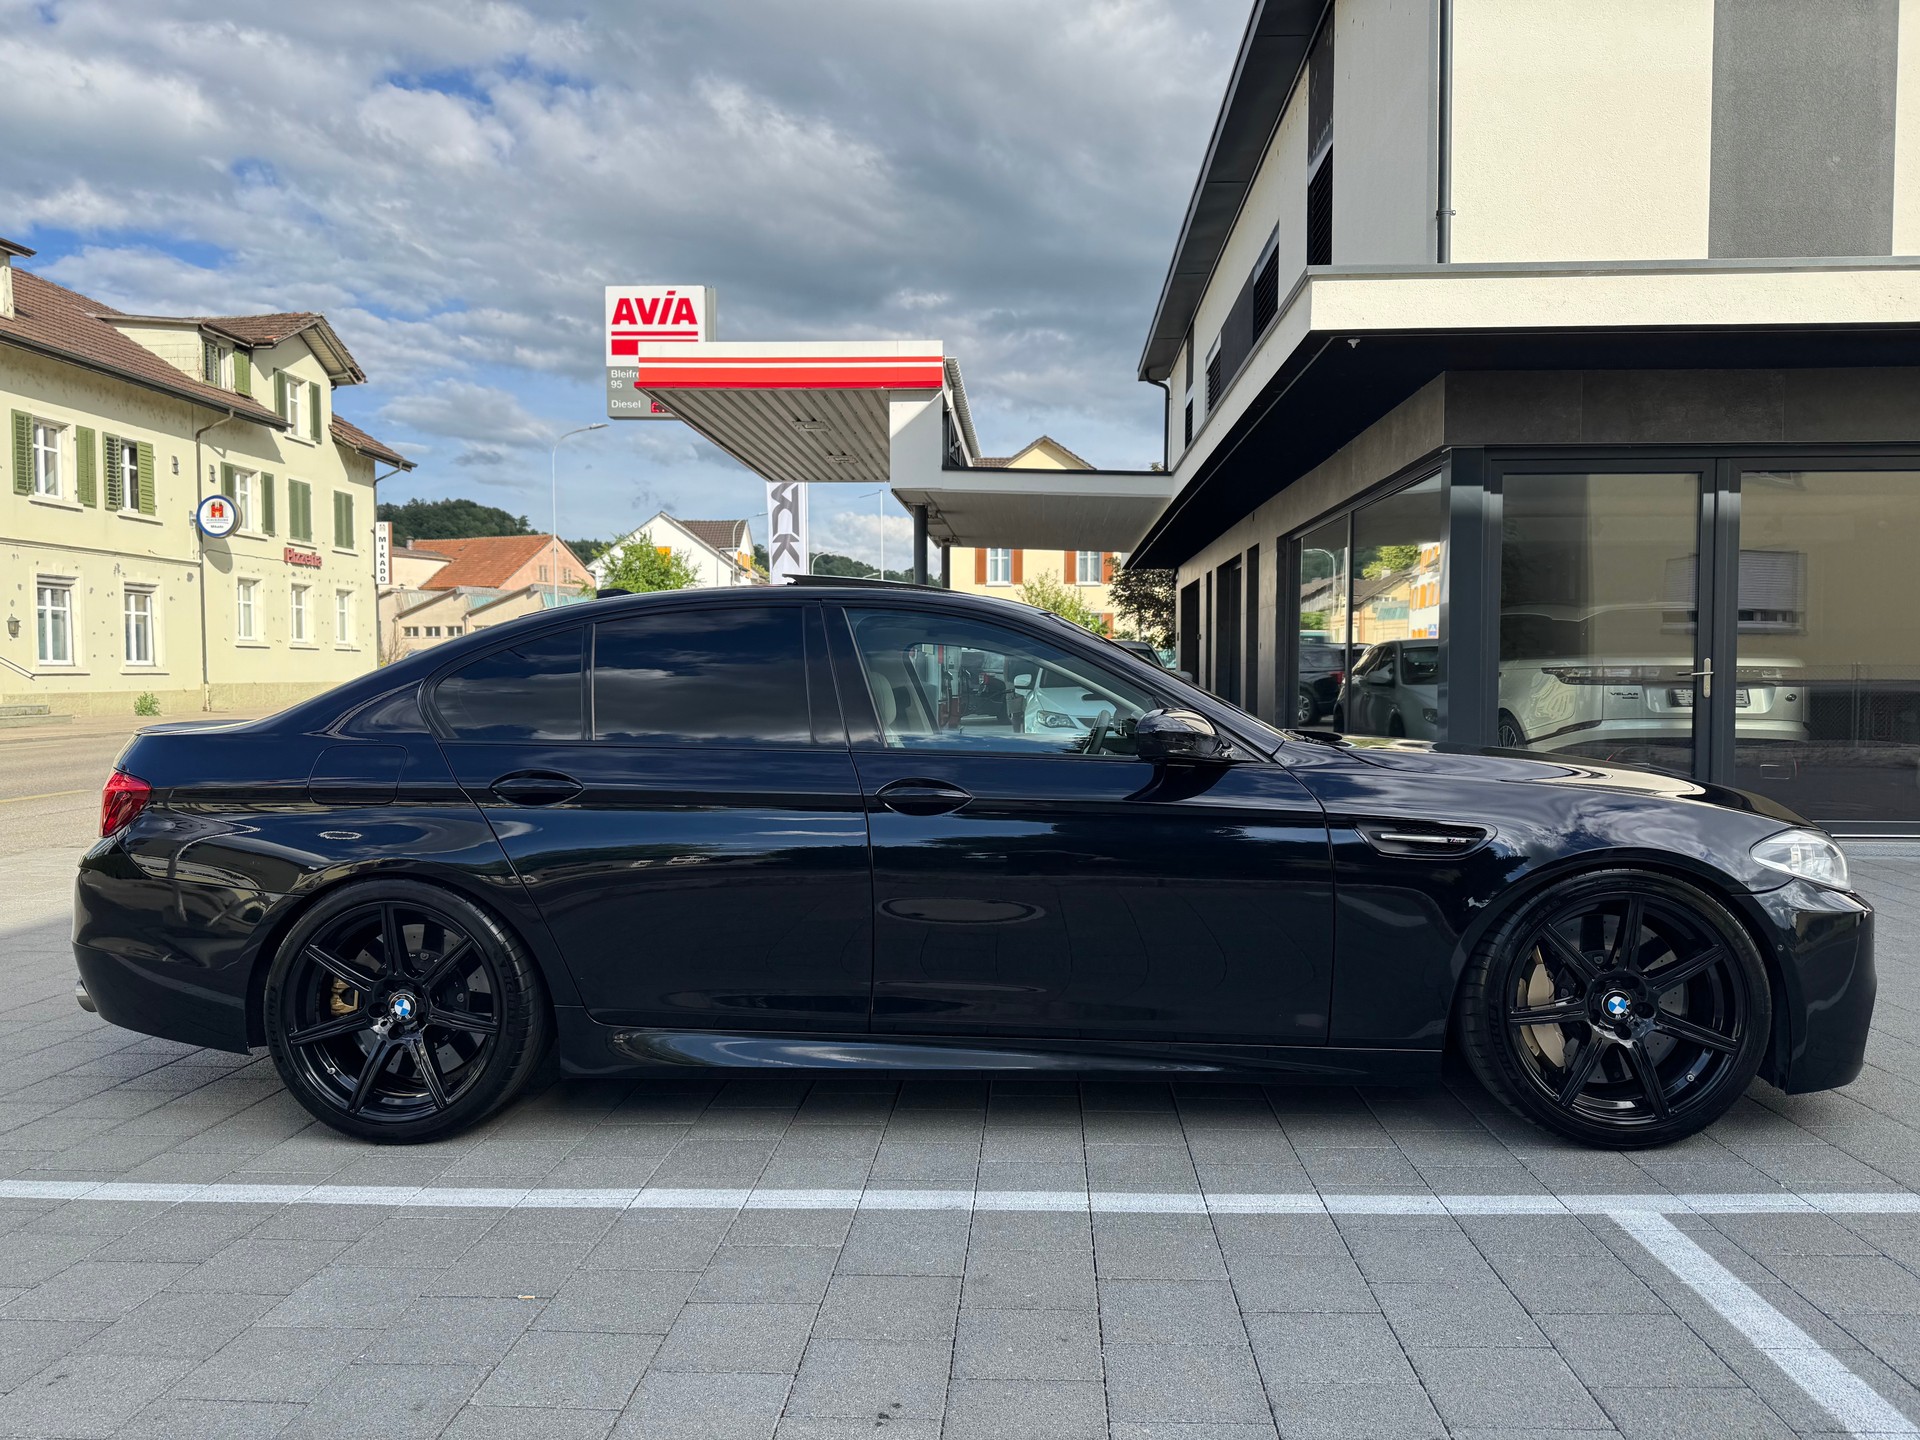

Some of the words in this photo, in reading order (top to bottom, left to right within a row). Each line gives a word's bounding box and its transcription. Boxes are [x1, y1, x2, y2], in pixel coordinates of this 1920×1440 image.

[611, 290, 698, 325] AVIA
[610, 380, 623, 389] 95
[611, 400, 641, 408] Diesel
[378, 536, 387, 582] MIKADO
